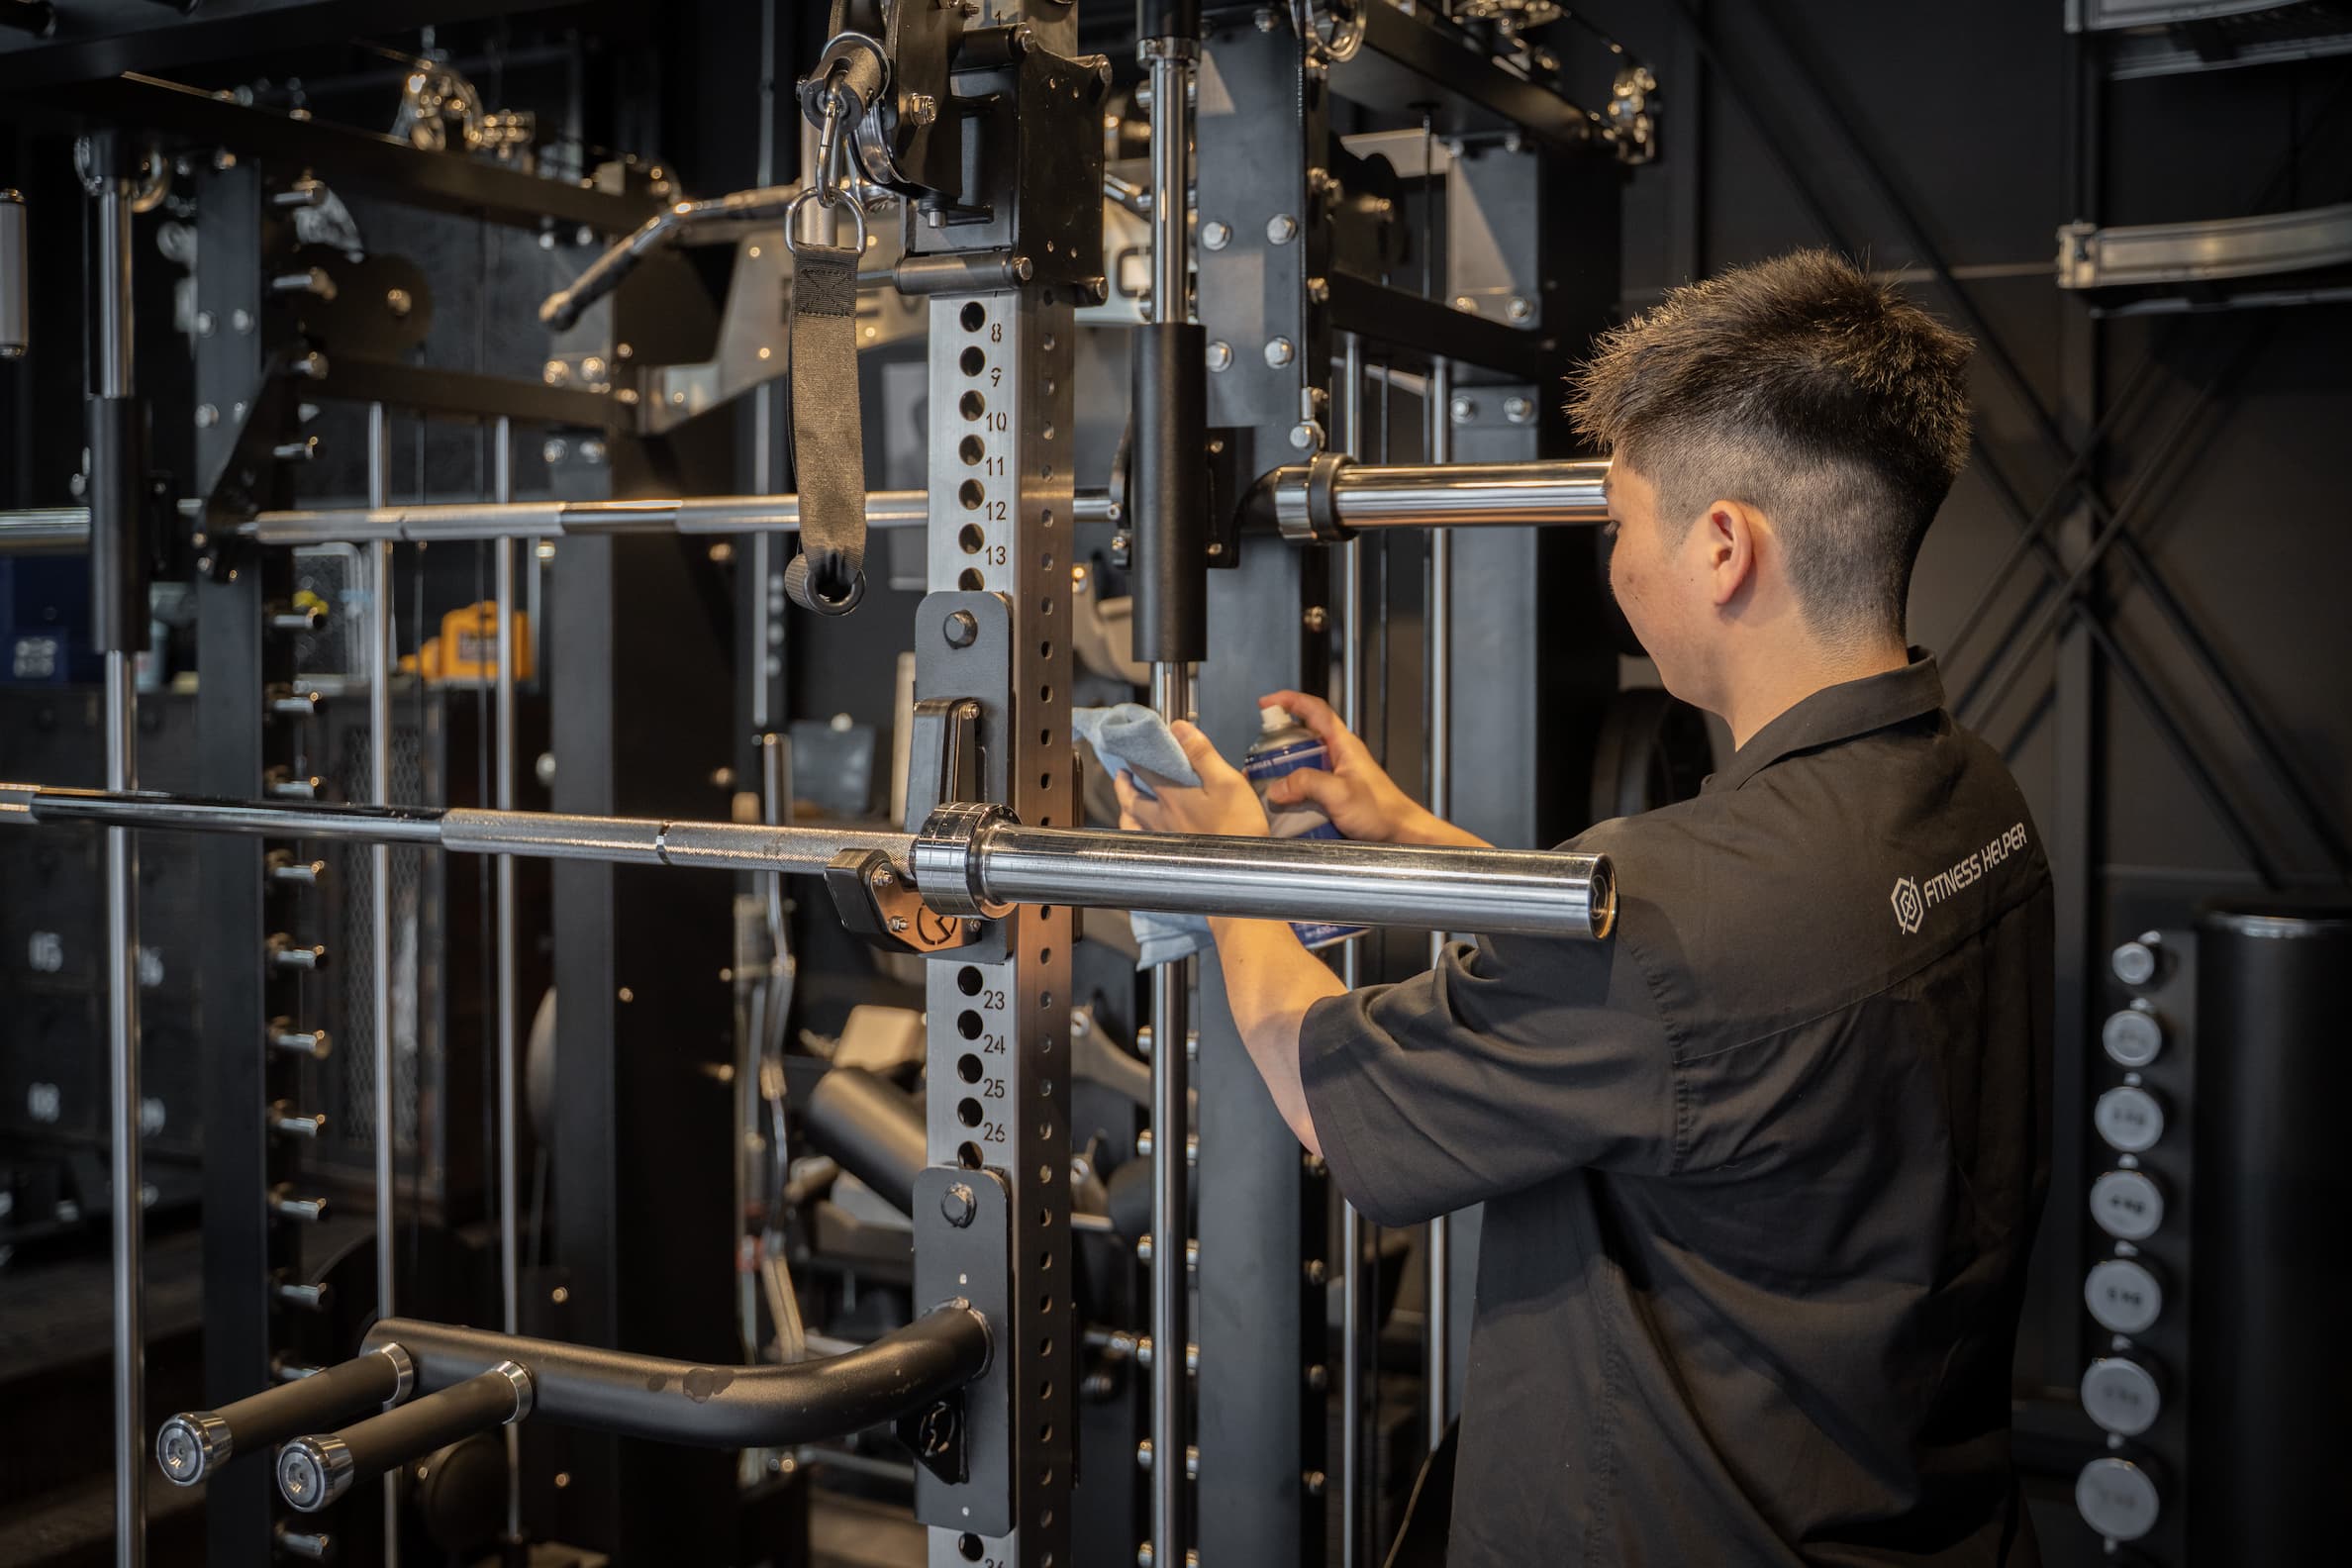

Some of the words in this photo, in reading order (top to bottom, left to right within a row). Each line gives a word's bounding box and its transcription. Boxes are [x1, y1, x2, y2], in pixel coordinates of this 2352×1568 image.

[991, 324, 1003, 343] 8
[991, 367, 1002, 387] 9
[986, 412, 1007, 432] 10
[986, 456, 1004, 476] 11
[986, 501, 1007, 521] 12
[986, 545, 1007, 565] 13
[1923, 853, 1982, 908] FITNESS
[1981, 822, 2028, 872] HELPER
[983, 990, 1005, 1010] 23
[983, 1034, 1006, 1054] 24
[983, 1078, 1005, 1099] 25
[983, 1122, 1006, 1142] 26
